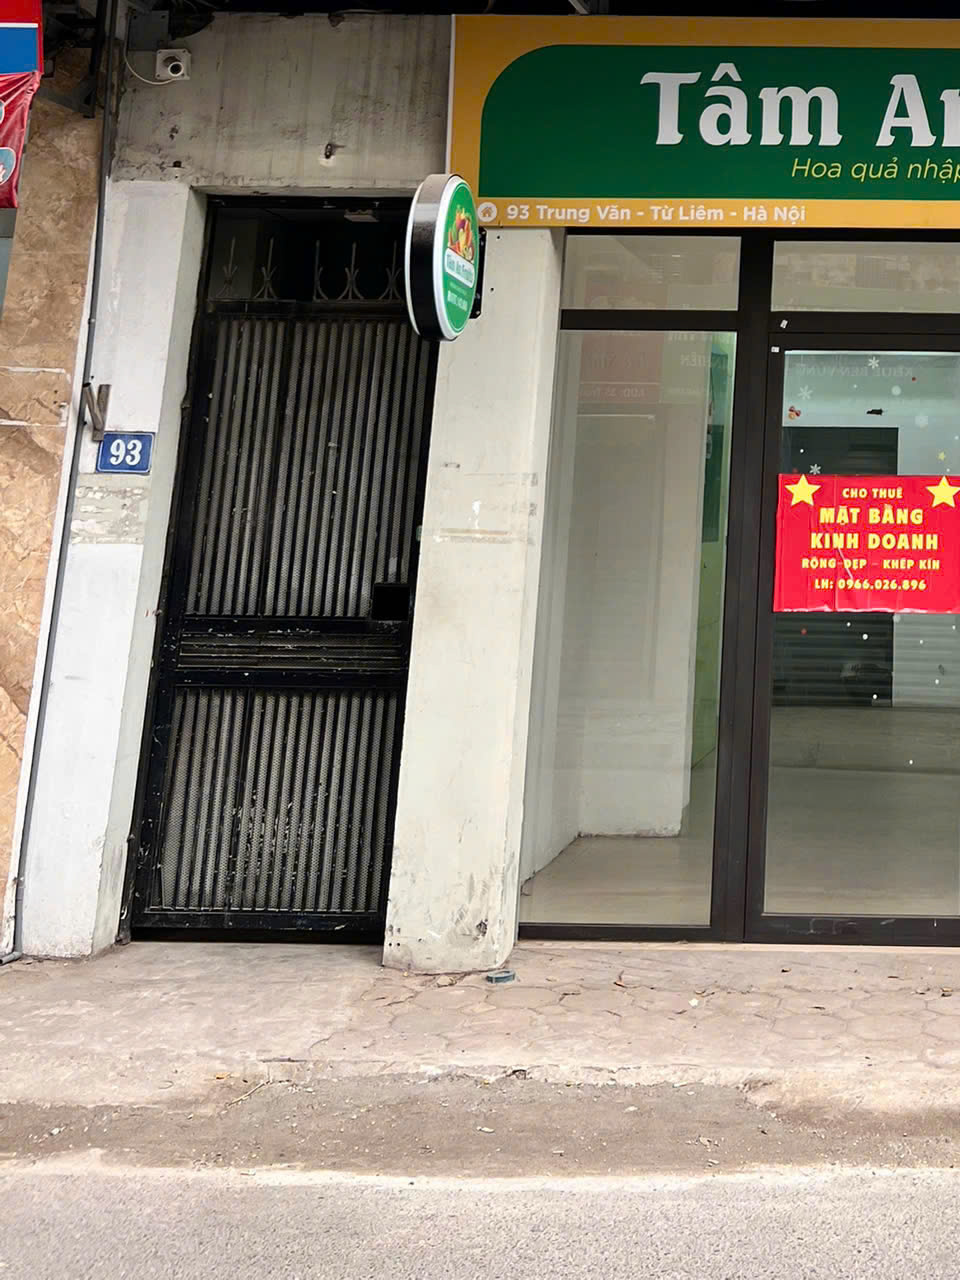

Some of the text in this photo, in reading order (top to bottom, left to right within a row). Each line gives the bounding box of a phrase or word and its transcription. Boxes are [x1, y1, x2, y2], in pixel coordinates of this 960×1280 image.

[640, 62, 843, 147] Tâm
[791, 157, 842, 179] Hoa
[851, 157, 898, 183] quả
[506, 205, 530, 220] 93
[536, 205, 591, 223] Trung
[596, 205, 631, 220] Văn
[650, 205, 674, 221] Từ
[679, 205, 724, 221] Liêm
[743, 206, 768, 221] Hà
[773, 205, 806, 225] Nội
[110, 439, 142, 466] 93
[842, 486, 903, 499] CHO THUÊ
[819, 504, 924, 525] MẶT BẰNG
[811, 533, 939, 551] KINH DOANH
[883, 558, 915, 570] KHÉP
[918, 558, 940, 570] KÍN
[815, 579, 927, 591] LH: 0966.026.896
